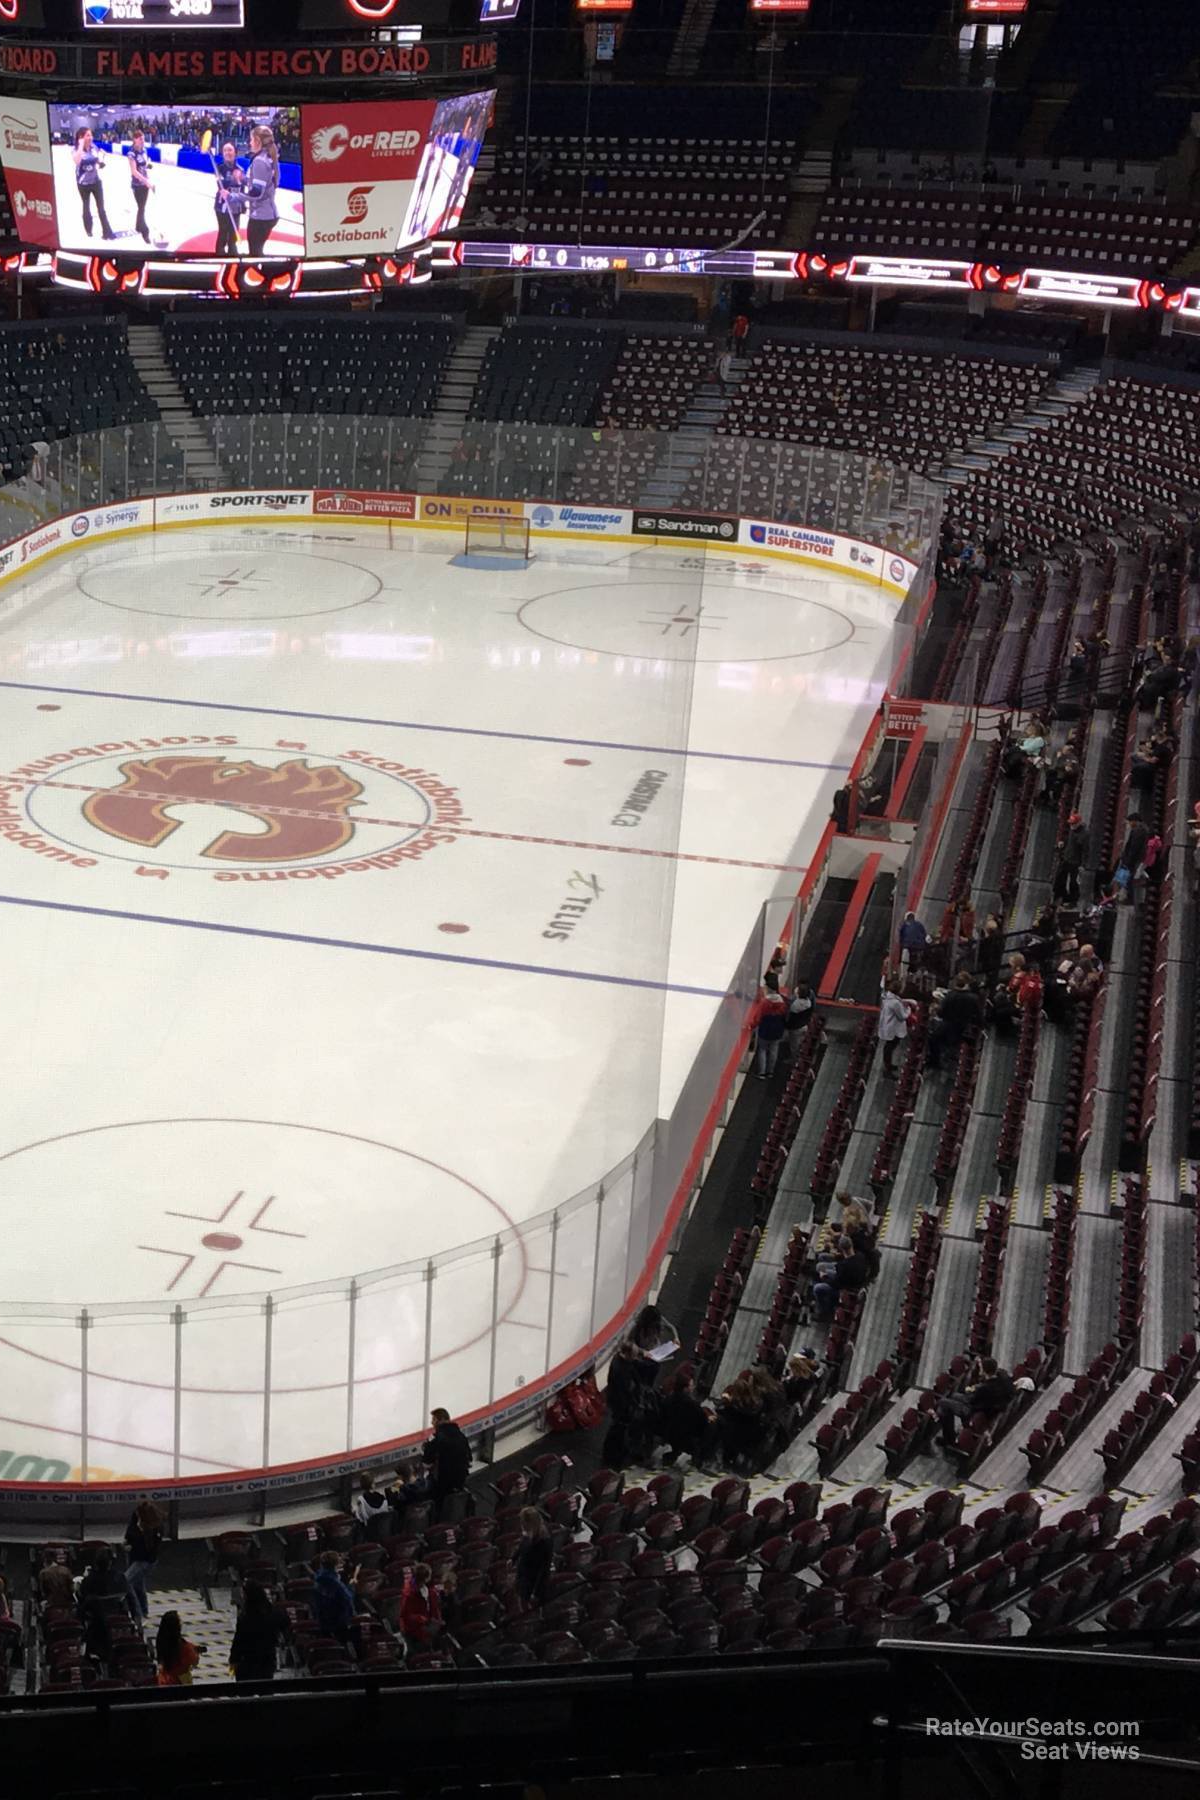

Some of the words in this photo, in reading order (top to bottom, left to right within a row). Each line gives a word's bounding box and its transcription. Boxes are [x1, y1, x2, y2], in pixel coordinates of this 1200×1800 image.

[8, 47, 57, 73] BOARD
[96, 50, 204, 76] FLAMES
[211, 48, 332, 75] ENERGY
[341, 46, 430, 74] BOARD
[350, 134, 374, 149] OF
[373, 130, 421, 151] RED
[313, 227, 388, 243] Scotiabank
[210, 494, 309, 508] SPORTSNET
[425, 502, 451, 516] ON
[106, 510, 139, 525] Synergy
[559, 508, 623, 523] Wawanesa
[566, 521, 606, 530] Insurance
[658, 518, 719, 533] Sandman
[768, 527, 790, 537] REAL
[791, 531, 835, 546] CANADIAN
[767, 536, 834, 557] SUPERSTORE
[888, 720, 918, 731] BETTE
[10, 734, 239, 779] Scotiabank
[335, 749, 472, 828] Scotiabank
[213, 830, 458, 883] Saddledome
[542, 896, 593, 942] TELUS
[75, 1494, 105, 1503] KEEPING
